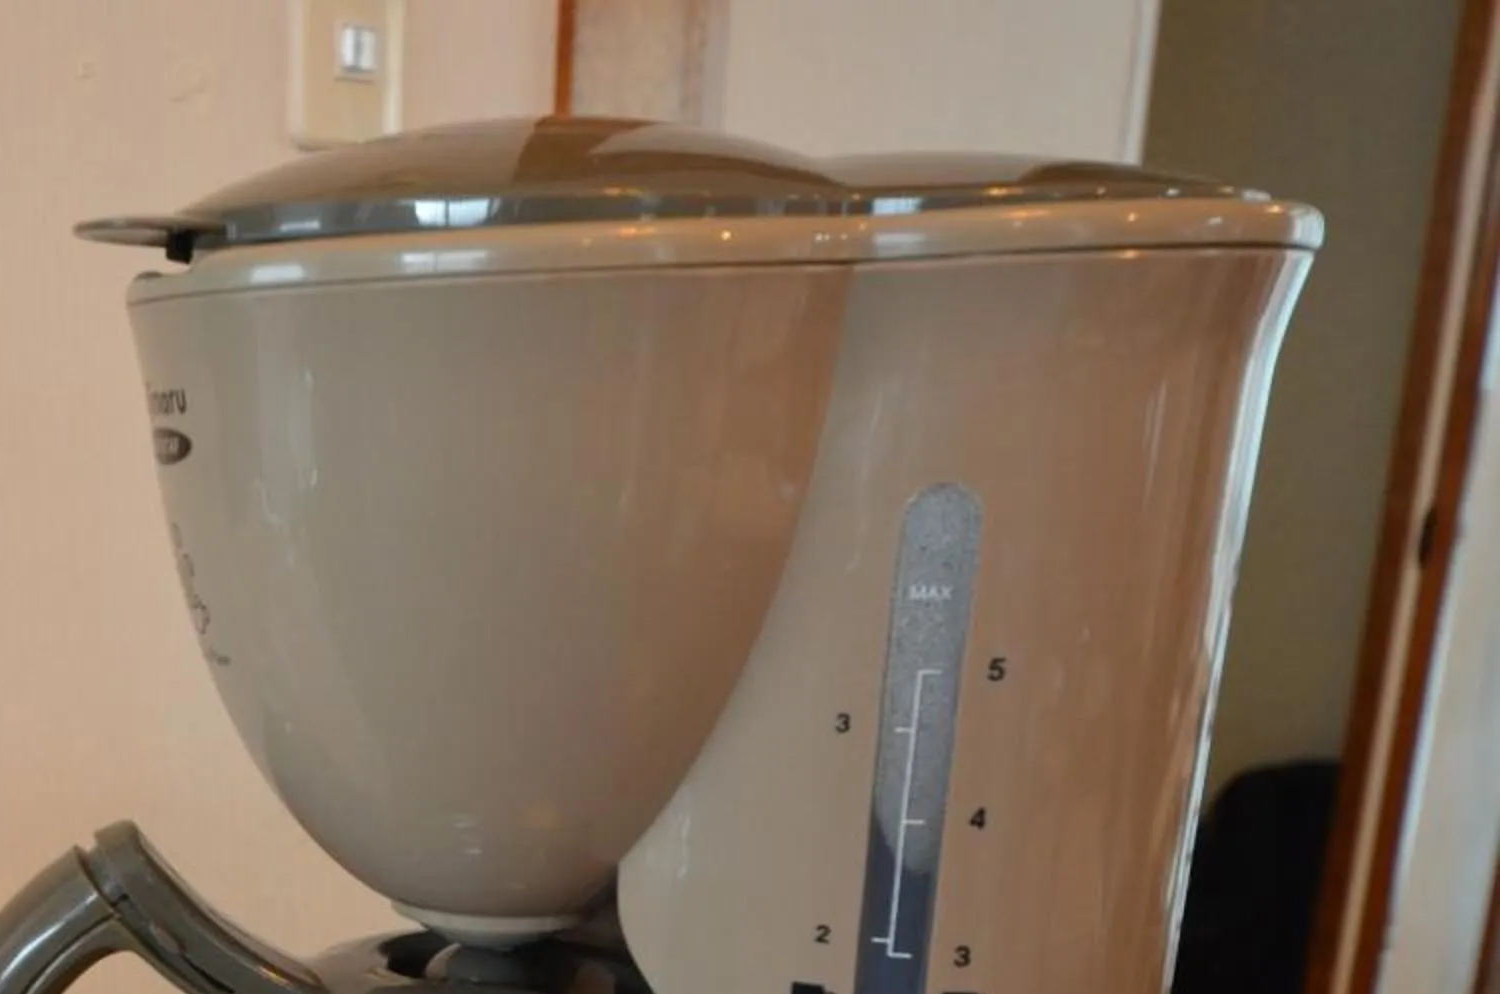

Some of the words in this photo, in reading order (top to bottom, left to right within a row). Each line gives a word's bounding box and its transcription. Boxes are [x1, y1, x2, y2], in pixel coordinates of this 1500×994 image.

[909, 585, 952, 600] MAX
[987, 657, 1007, 682] 5
[835, 713, 851, 733] 3
[968, 808, 986, 829] 4
[815, 924, 831, 944] 2
[953, 946, 971, 968] 3
